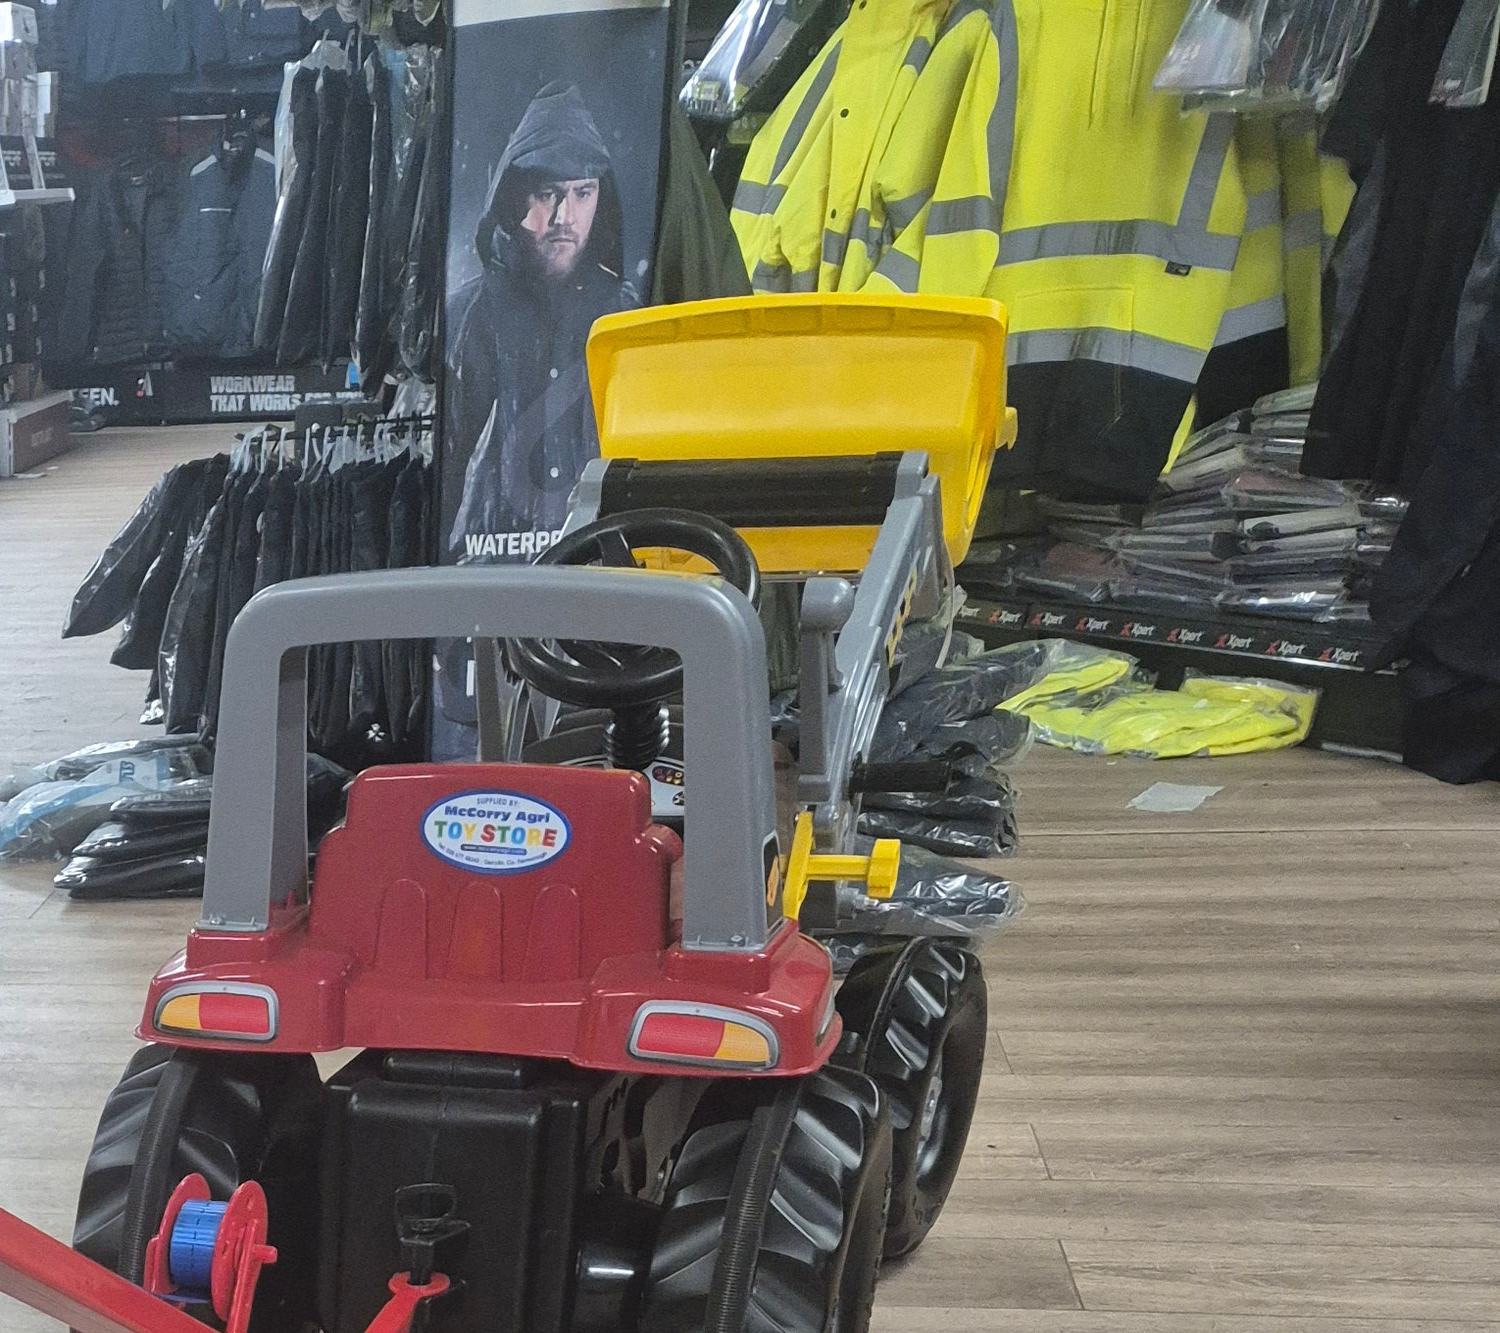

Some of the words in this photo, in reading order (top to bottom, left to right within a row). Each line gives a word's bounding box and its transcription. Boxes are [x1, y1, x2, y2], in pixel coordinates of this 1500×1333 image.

[209, 374, 296, 394] WORKWEAR
[209, 394, 246, 412] THAT
[249, 393, 301, 412] WORKS
[476, 797, 508, 806] SUPPLIED
[444, 805, 511, 822] McCorry
[515, 811, 550, 824] Agri
[434, 820, 477, 841] TOY
[480, 823, 558, 848] STORE
